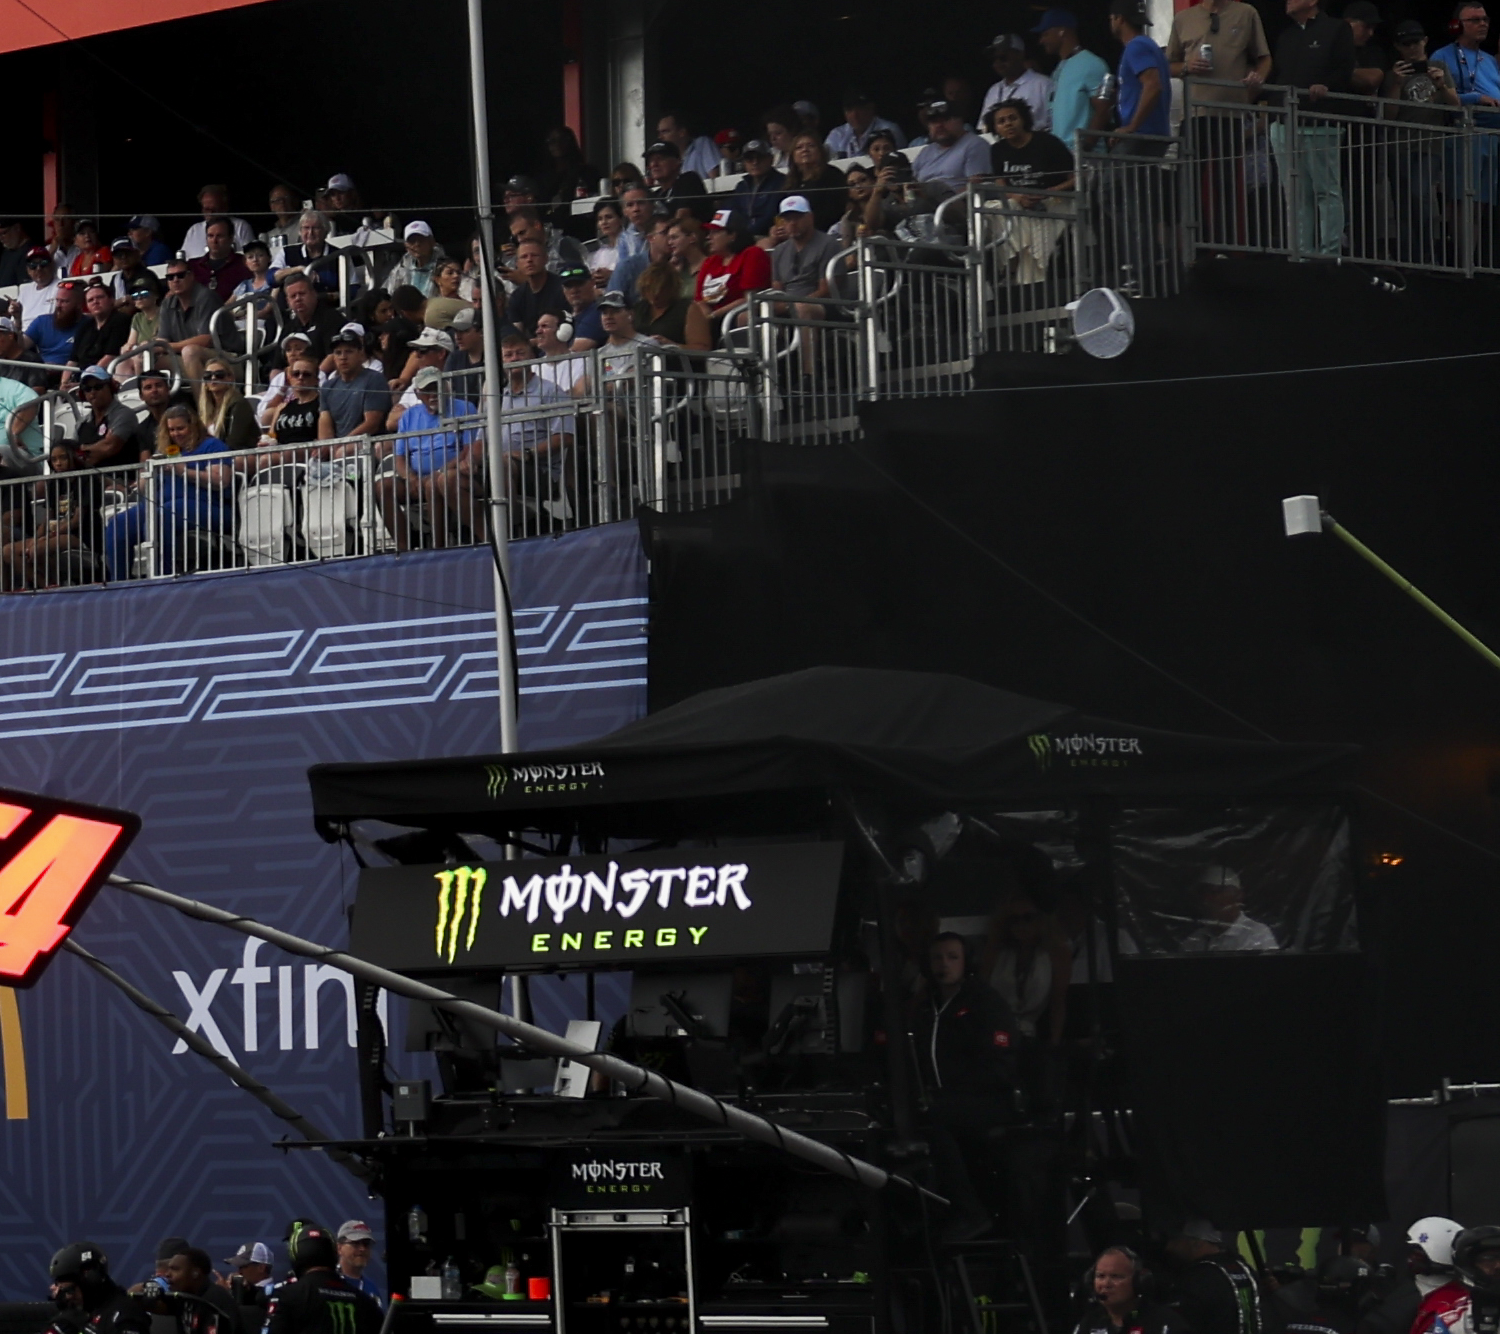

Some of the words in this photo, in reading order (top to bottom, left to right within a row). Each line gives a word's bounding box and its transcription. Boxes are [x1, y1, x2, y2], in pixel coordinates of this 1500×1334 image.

[525, 782, 588, 793] ENERGY
[531, 926, 708, 952] ENERGY
[586, 1184, 651, 1193] ENERGY
